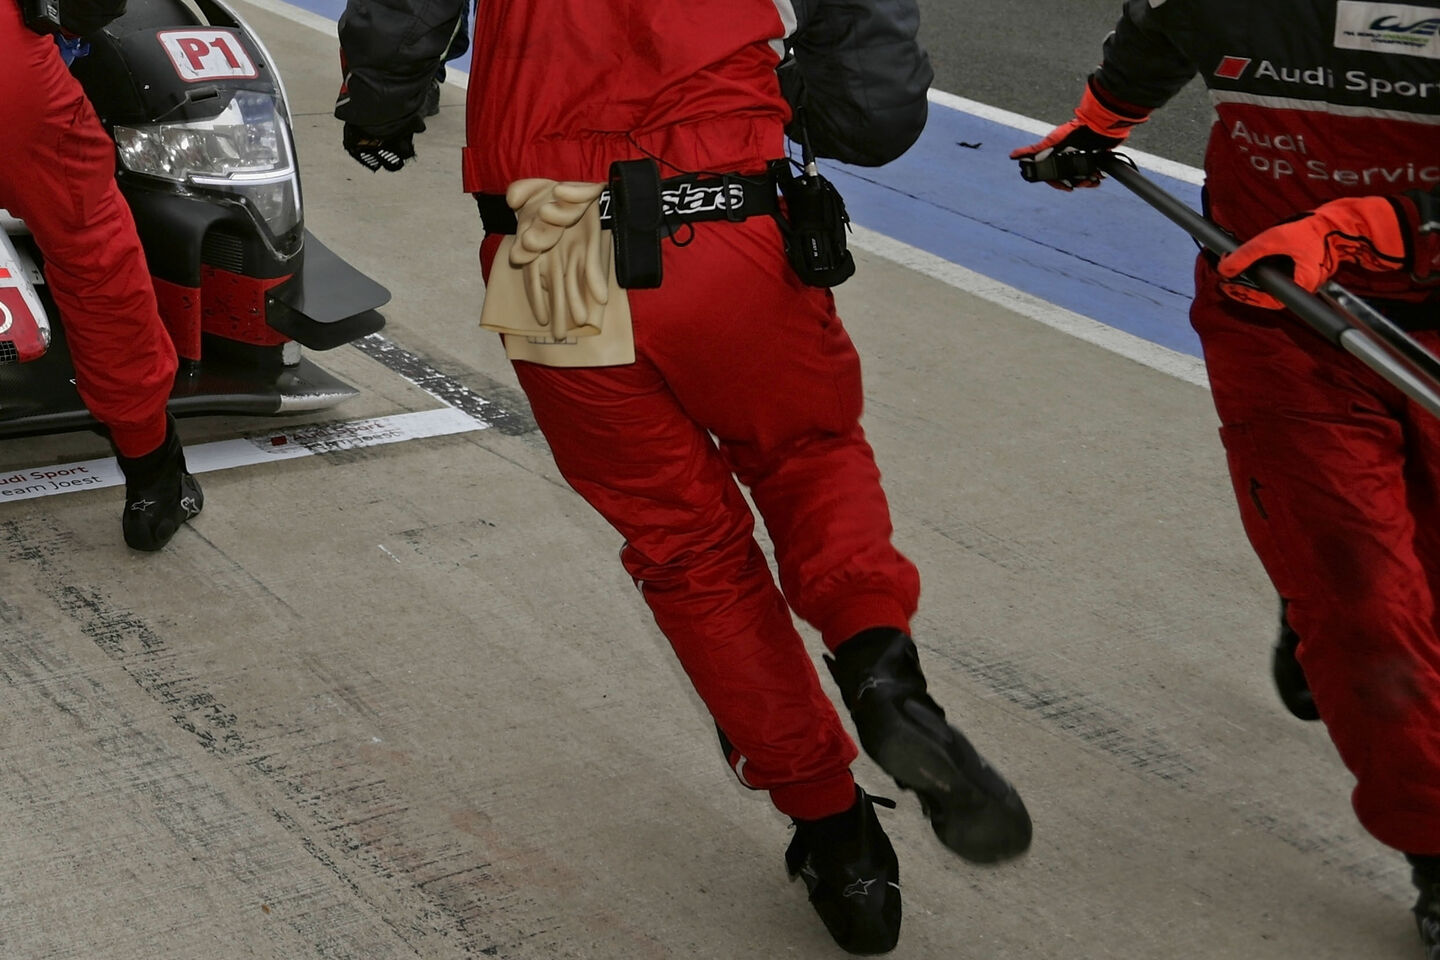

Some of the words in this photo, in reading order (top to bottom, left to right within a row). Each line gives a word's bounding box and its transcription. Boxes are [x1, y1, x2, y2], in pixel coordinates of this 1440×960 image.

[175, 37, 242, 71] P1
[1253, 59, 1335, 89] Audi
[1344, 69, 1440, 99] Spor
[1231, 119, 1308, 155] Audi
[30, 465, 89, 480] Sport
[49, 475, 104, 490] Joest
